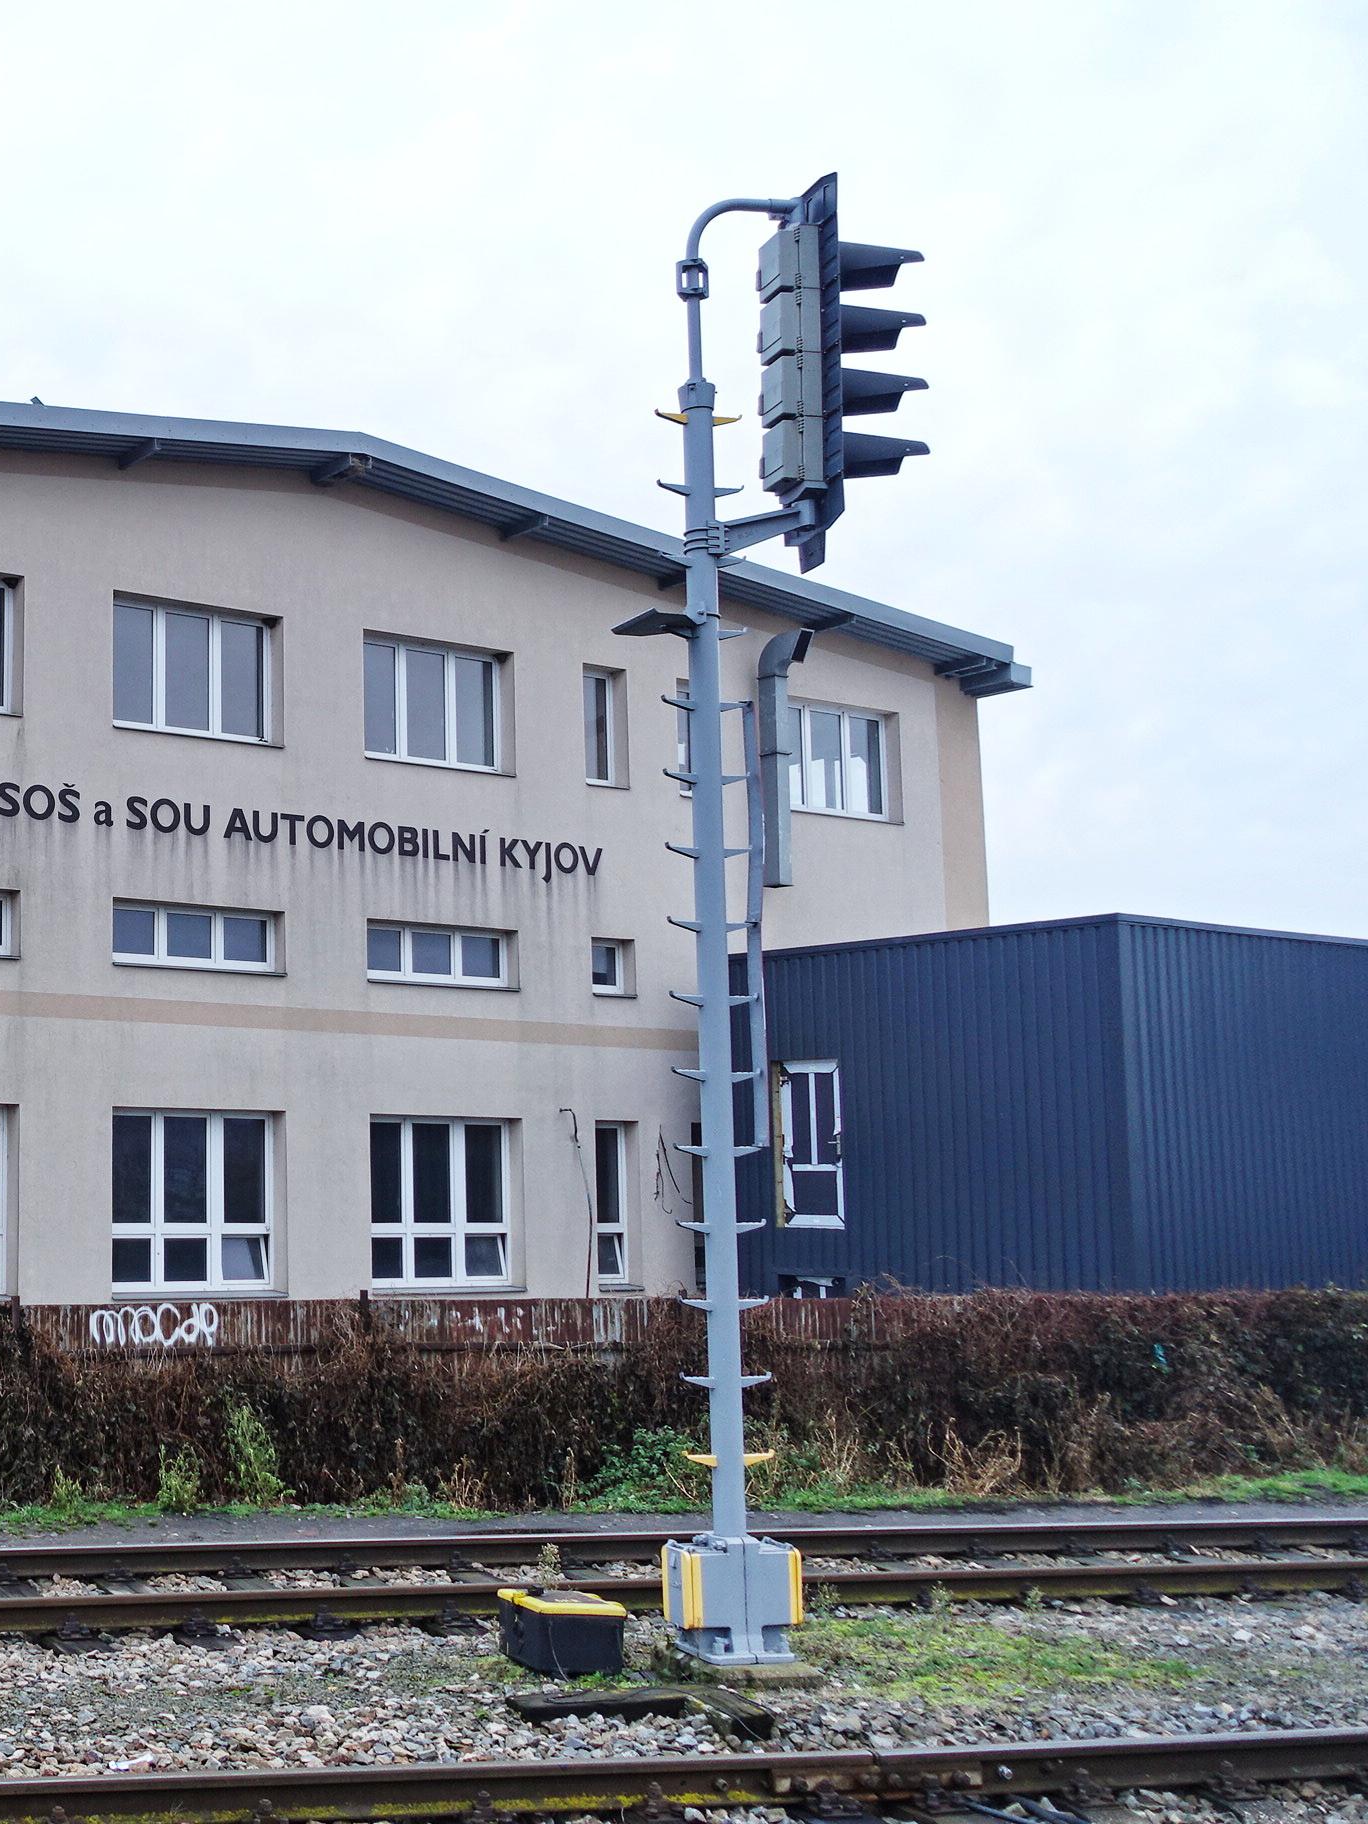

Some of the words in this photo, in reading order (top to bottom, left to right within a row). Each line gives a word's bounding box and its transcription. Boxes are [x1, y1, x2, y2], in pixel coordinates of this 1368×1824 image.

[93, 800, 114, 827] a
[126, 796, 211, 835] SOU
[223, 807, 489, 864] AUTOMOBILNÍ
[499, 837, 603, 883] KYJOV
